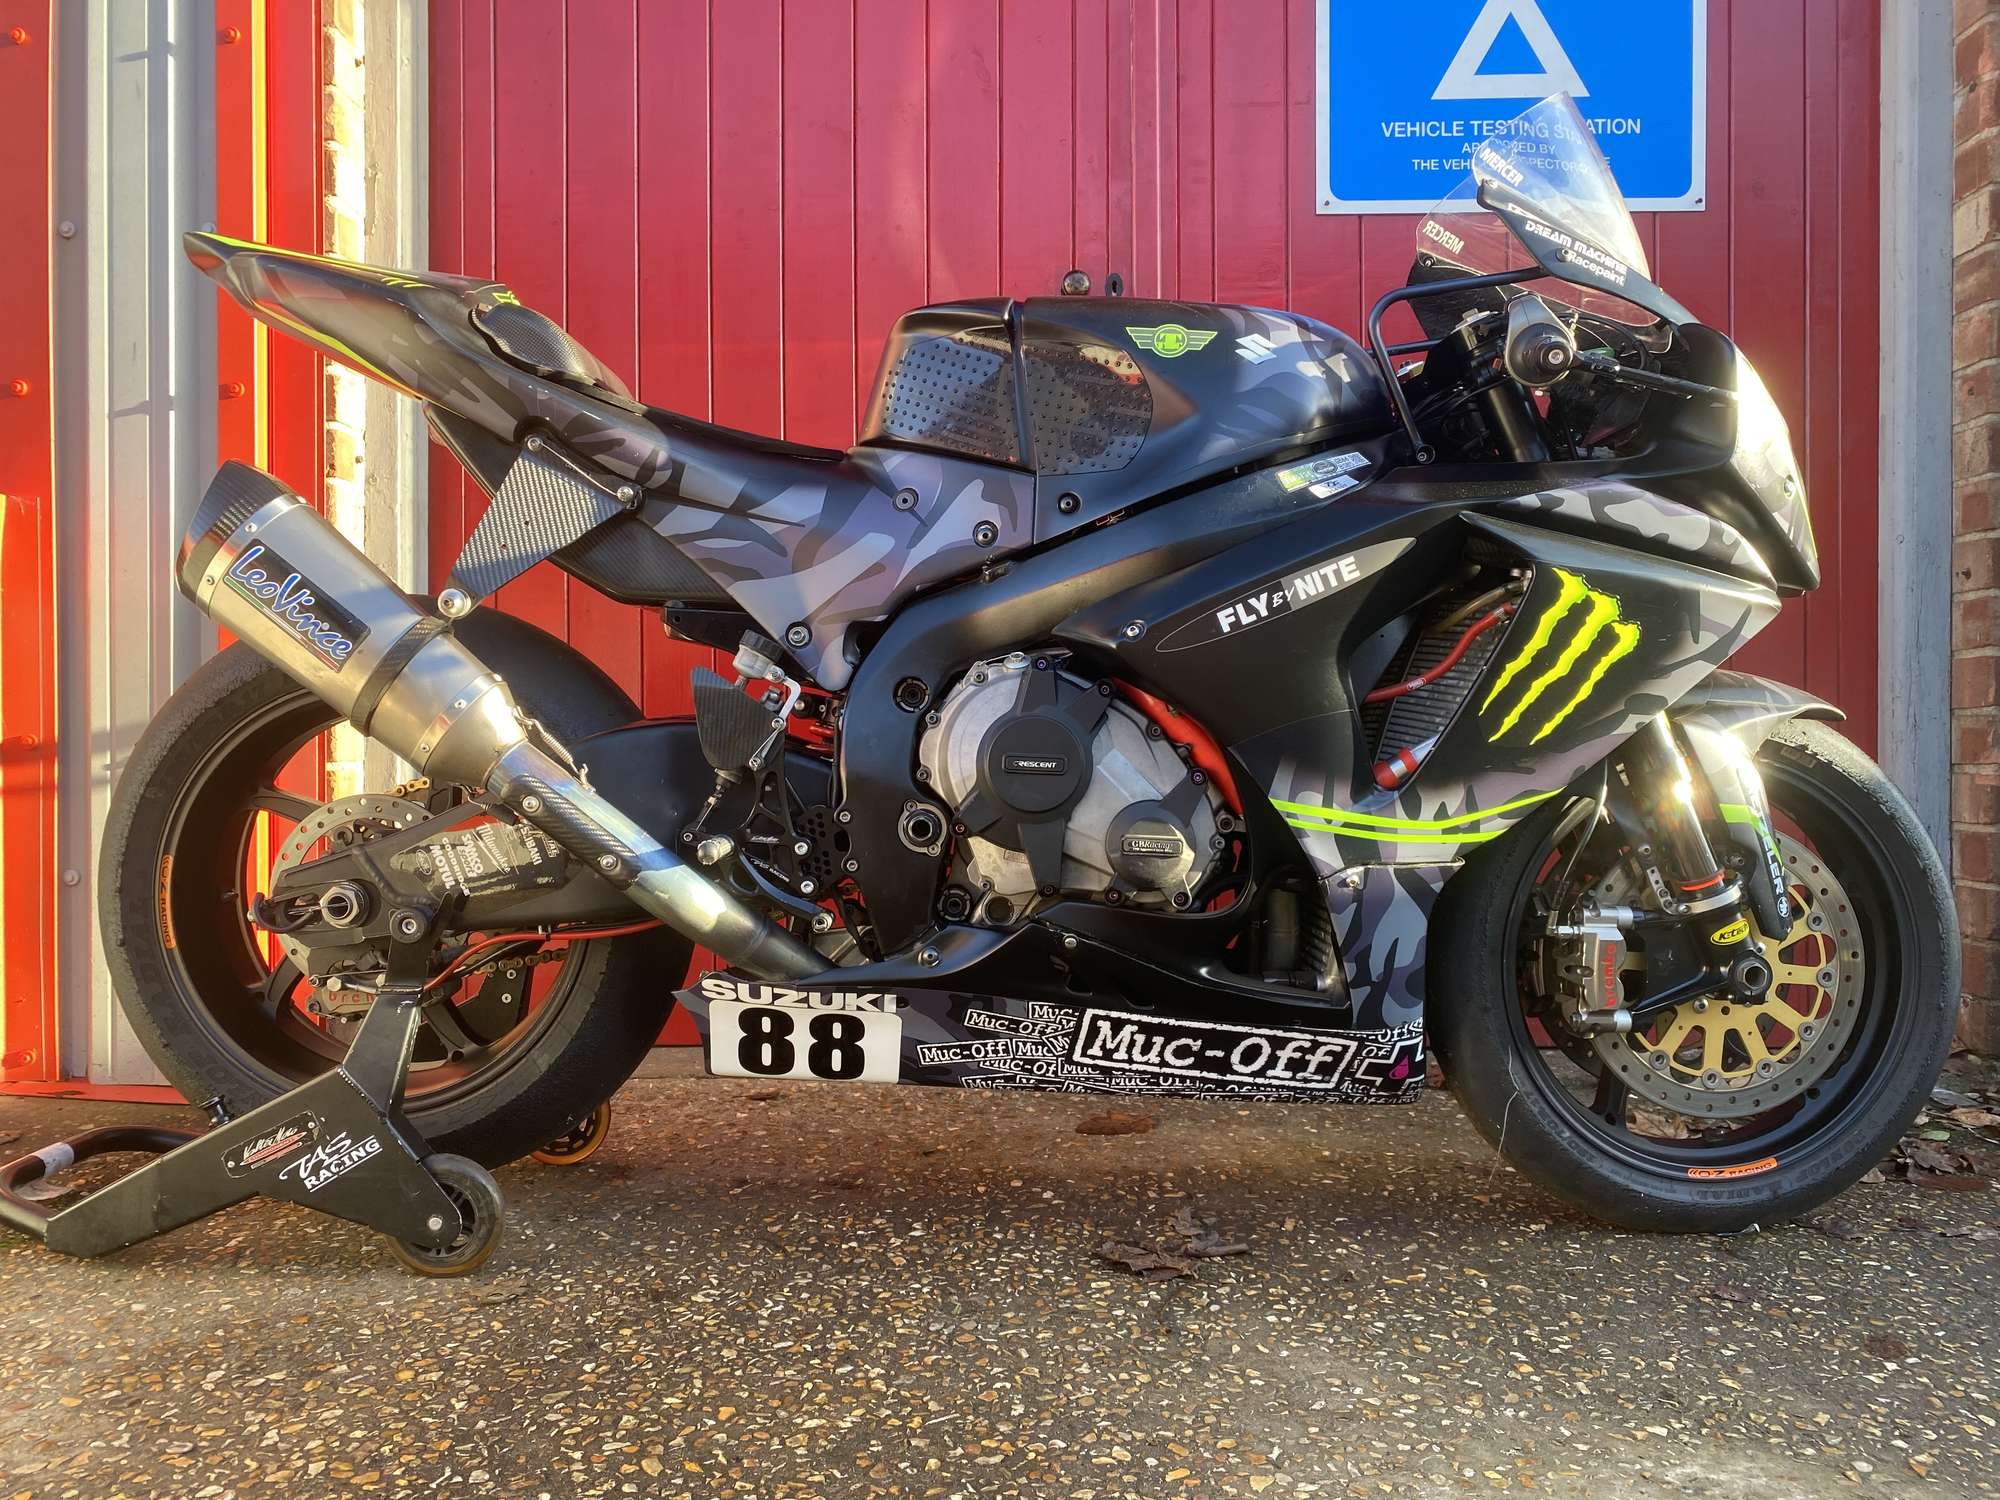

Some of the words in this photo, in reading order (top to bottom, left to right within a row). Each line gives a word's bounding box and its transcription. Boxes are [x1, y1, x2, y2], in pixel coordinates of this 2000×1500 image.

[1381, 120, 1465, 137] VEHICLE
[1470, 119, 1550, 138] TESTING
[1539, 143, 1556, 154] BY
[1412, 159, 1440, 170] THE
[1479, 146, 1525, 188] MERCER
[1525, 219, 1572, 248] DREAM
[1573, 240, 1628, 276] MACHINE
[1566, 249, 1626, 287] Racepaint
[229, 545, 353, 660] LeoVince
[1216, 591, 1269, 633] FLY
[1293, 555, 1361, 600] NITE
[1012, 760, 1057, 768] CRESCENT
[429, 845, 456, 890] MOTUL
[701, 979, 898, 1014] SUZUKI
[738, 1007, 866, 1080] 88
[922, 1041, 1008, 1063] Muc-Off
[1087, 1018, 1344, 1081] Muc-Off
[303, 1138, 381, 1190] RACING
